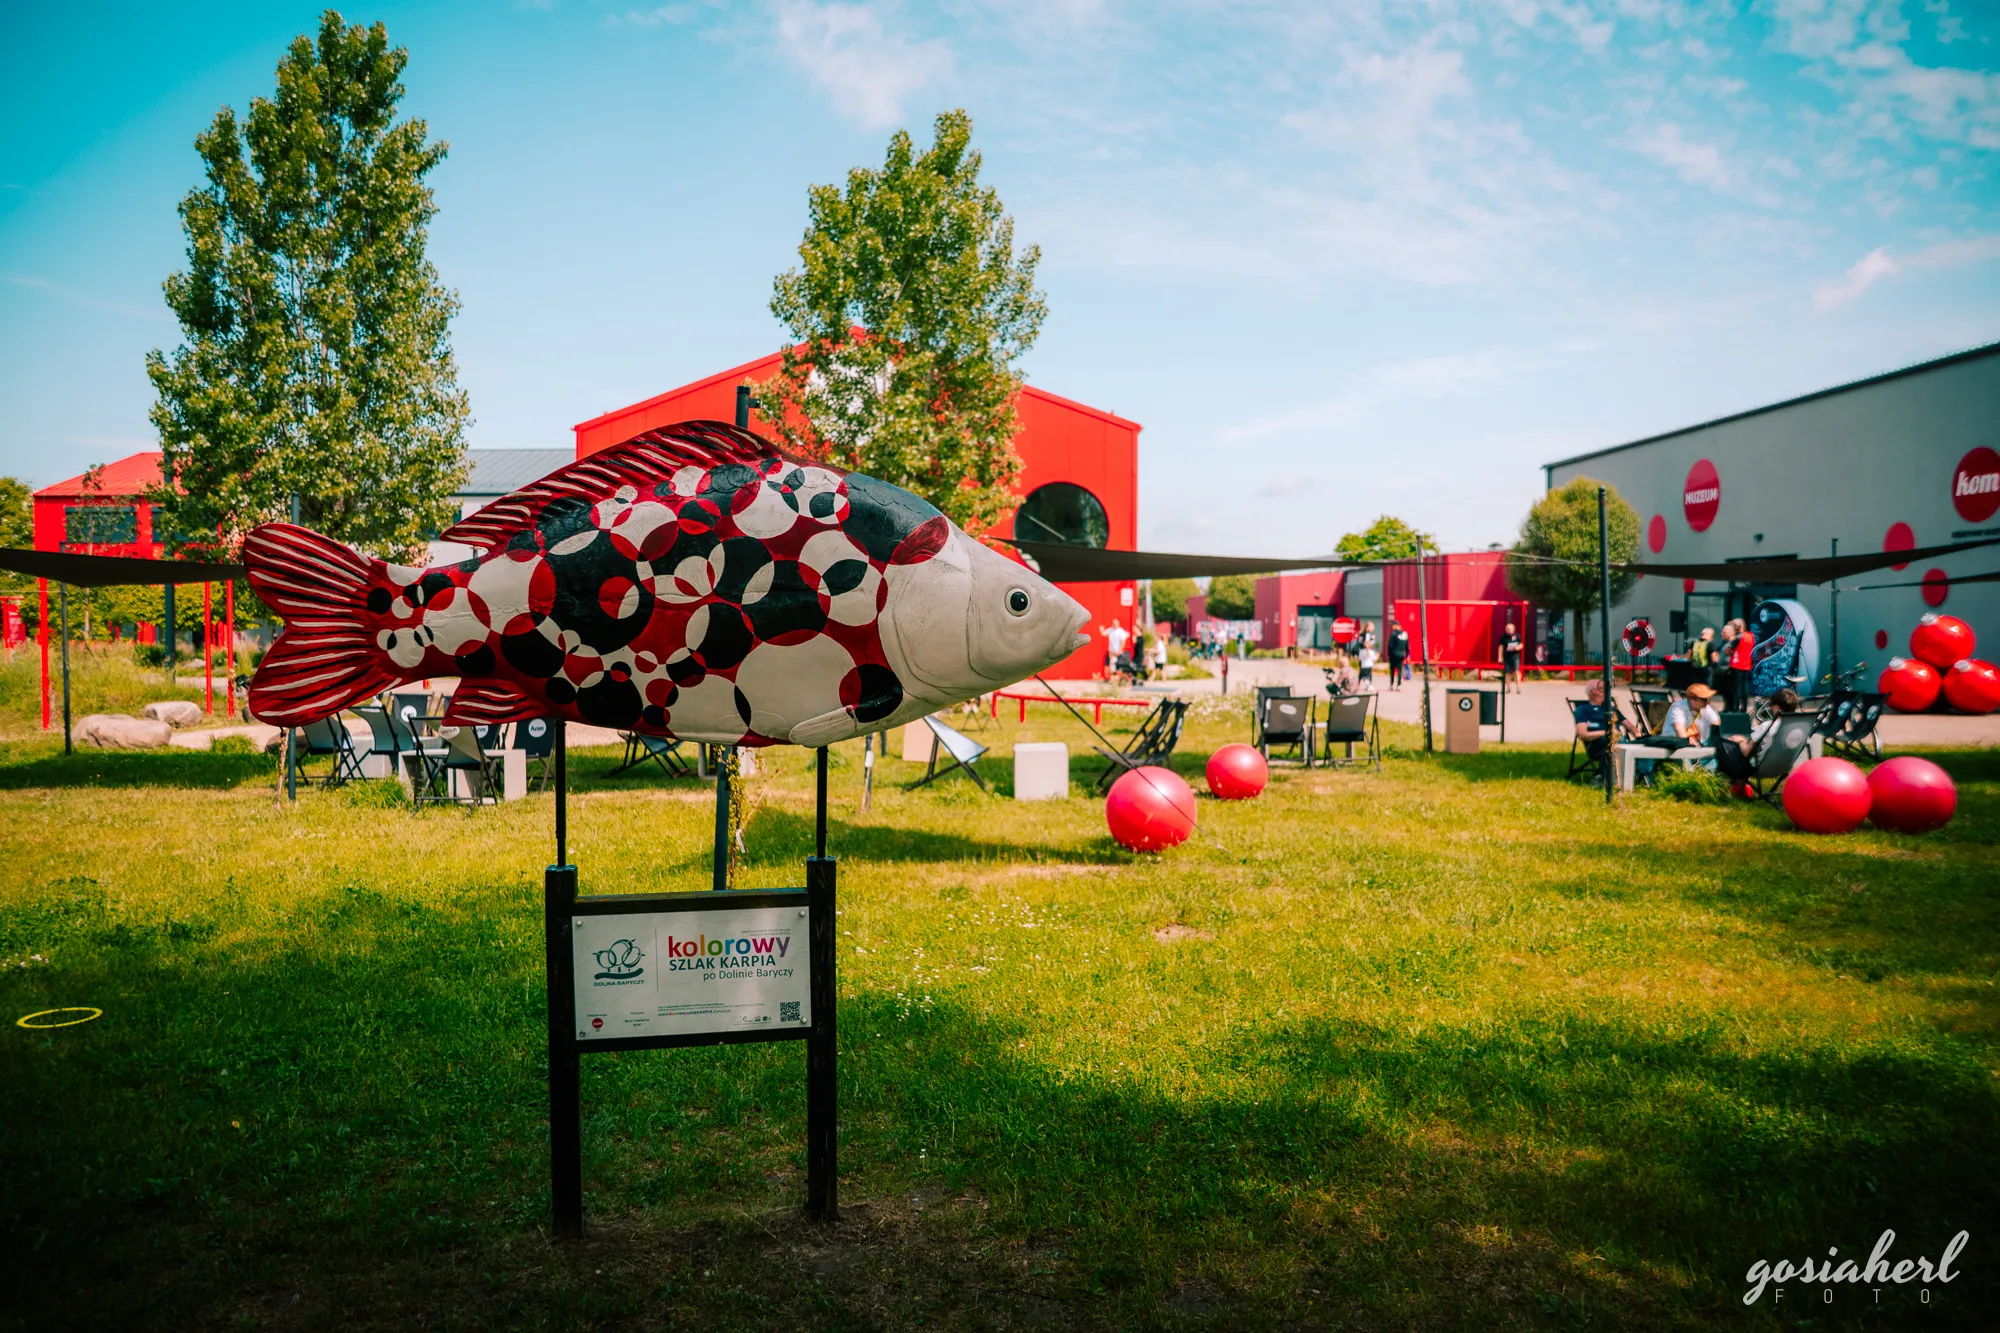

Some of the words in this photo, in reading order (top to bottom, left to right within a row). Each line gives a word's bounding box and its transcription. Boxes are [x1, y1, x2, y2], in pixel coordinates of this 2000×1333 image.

[1956, 470, 1999, 496] kom
[1685, 488, 1717, 505] MUZEUM
[668, 934, 790, 958] kolorowy
[669, 957, 715, 971] SZLAK
[720, 954, 776, 968] KARPIA
[703, 972, 716, 981] po
[719, 970, 753, 979] Dolinie
[756, 968, 793, 978] Baryczy
